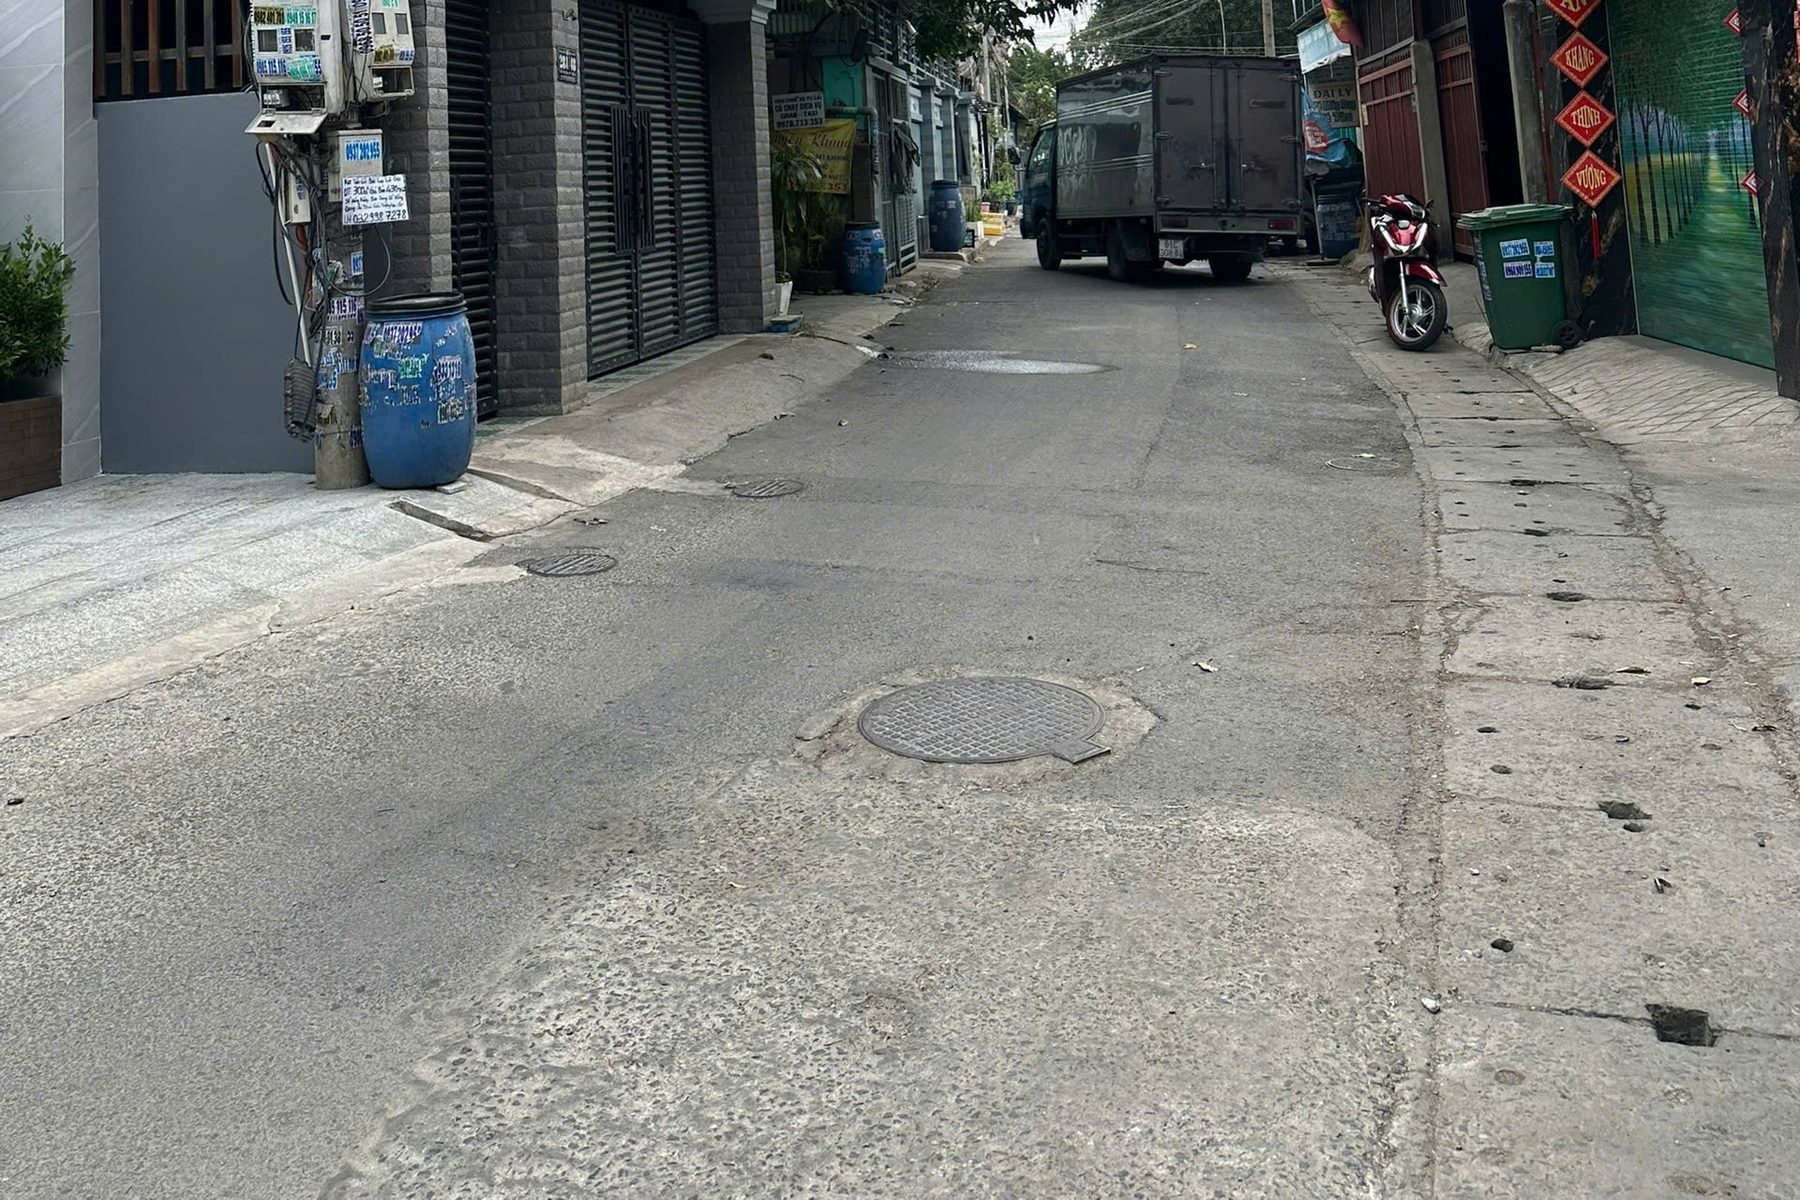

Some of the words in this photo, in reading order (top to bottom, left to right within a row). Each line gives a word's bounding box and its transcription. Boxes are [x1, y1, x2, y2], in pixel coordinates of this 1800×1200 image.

[1565, 45, 1595, 72] KHANG
[1571, 105, 1601, 135] THỊNH
[1576, 163, 1607, 196] VƯỢNG
